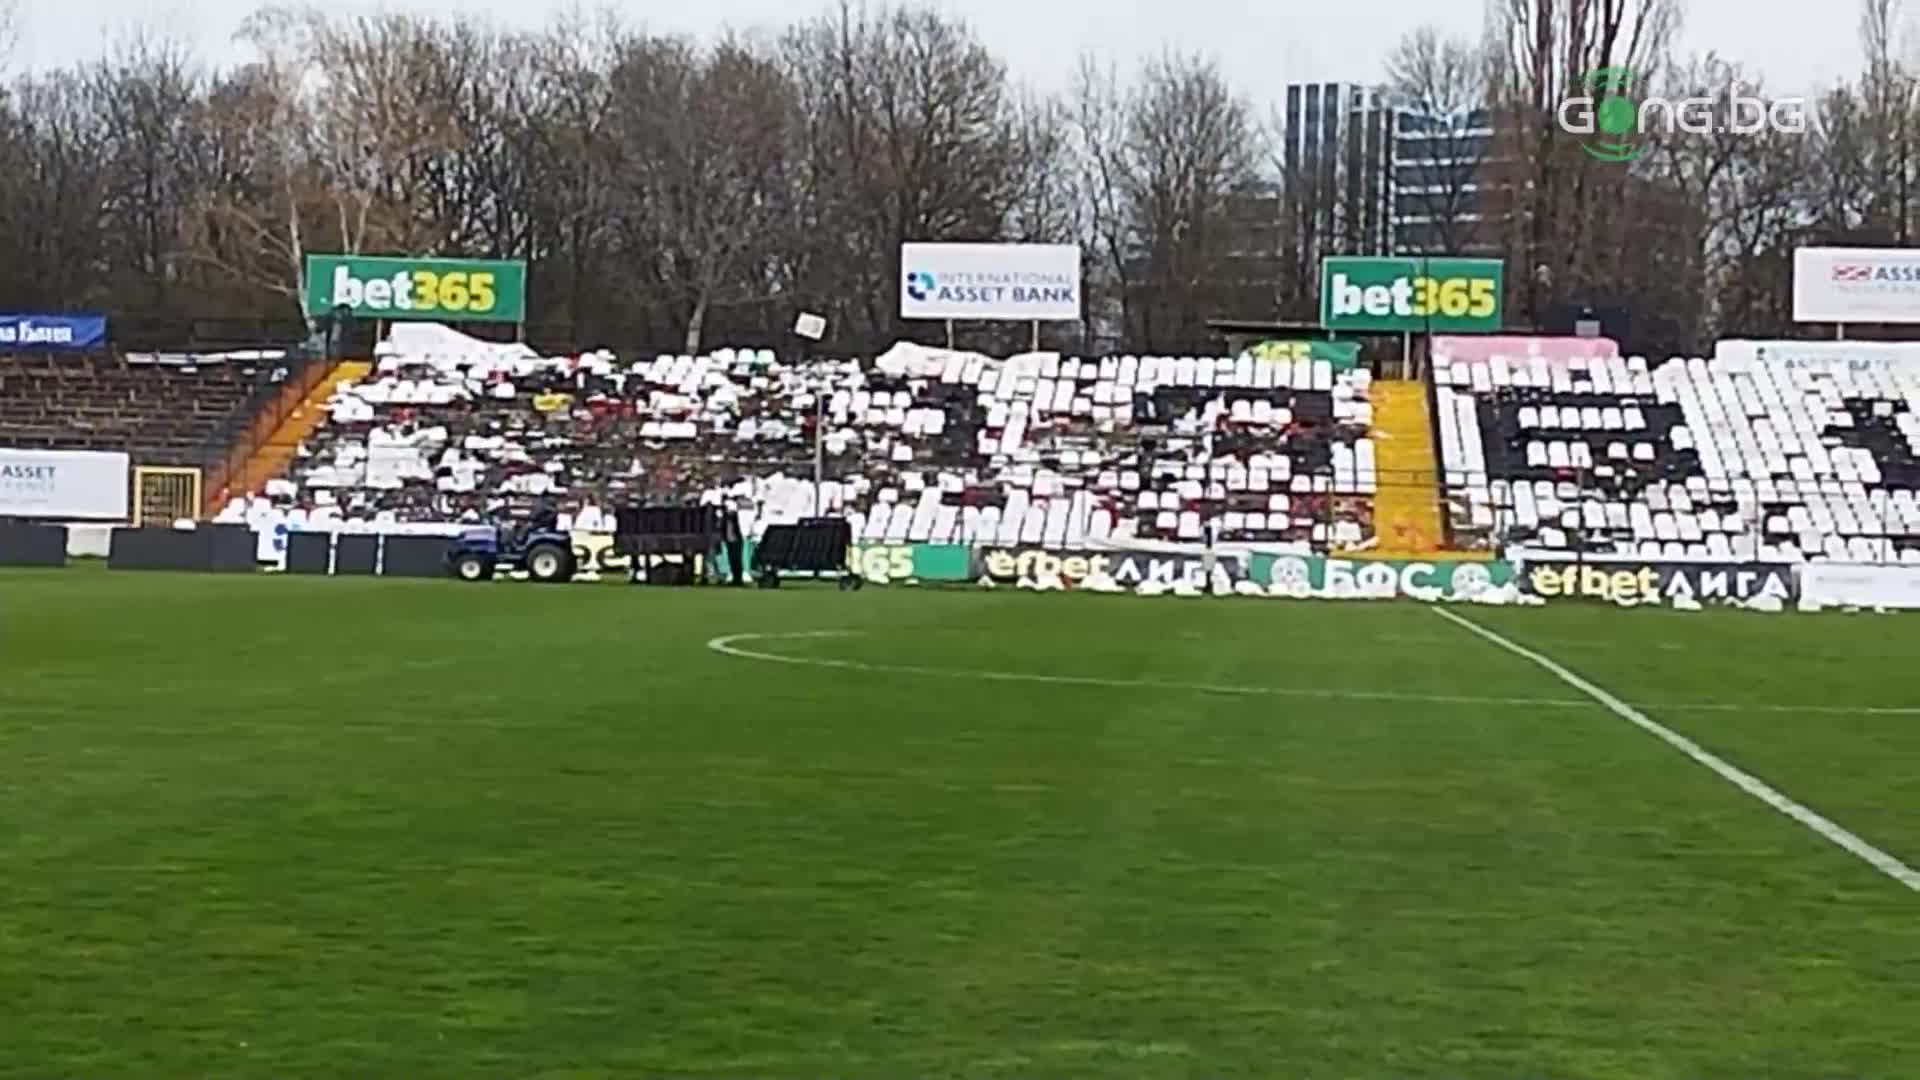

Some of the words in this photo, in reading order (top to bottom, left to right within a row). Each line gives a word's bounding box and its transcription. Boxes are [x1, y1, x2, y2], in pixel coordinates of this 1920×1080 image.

[333, 265, 496, 311] bet365
[938, 286, 1004, 302] ASSET
[1012, 286, 1074, 303] BANK
[1332, 273, 1496, 317] bet365
[2, 465, 56, 479] ASSET
[1325, 559, 1440, 597] БФС
[1530, 564, 1660, 597] efbet
[1665, 570, 1789, 599] ЛИГА
